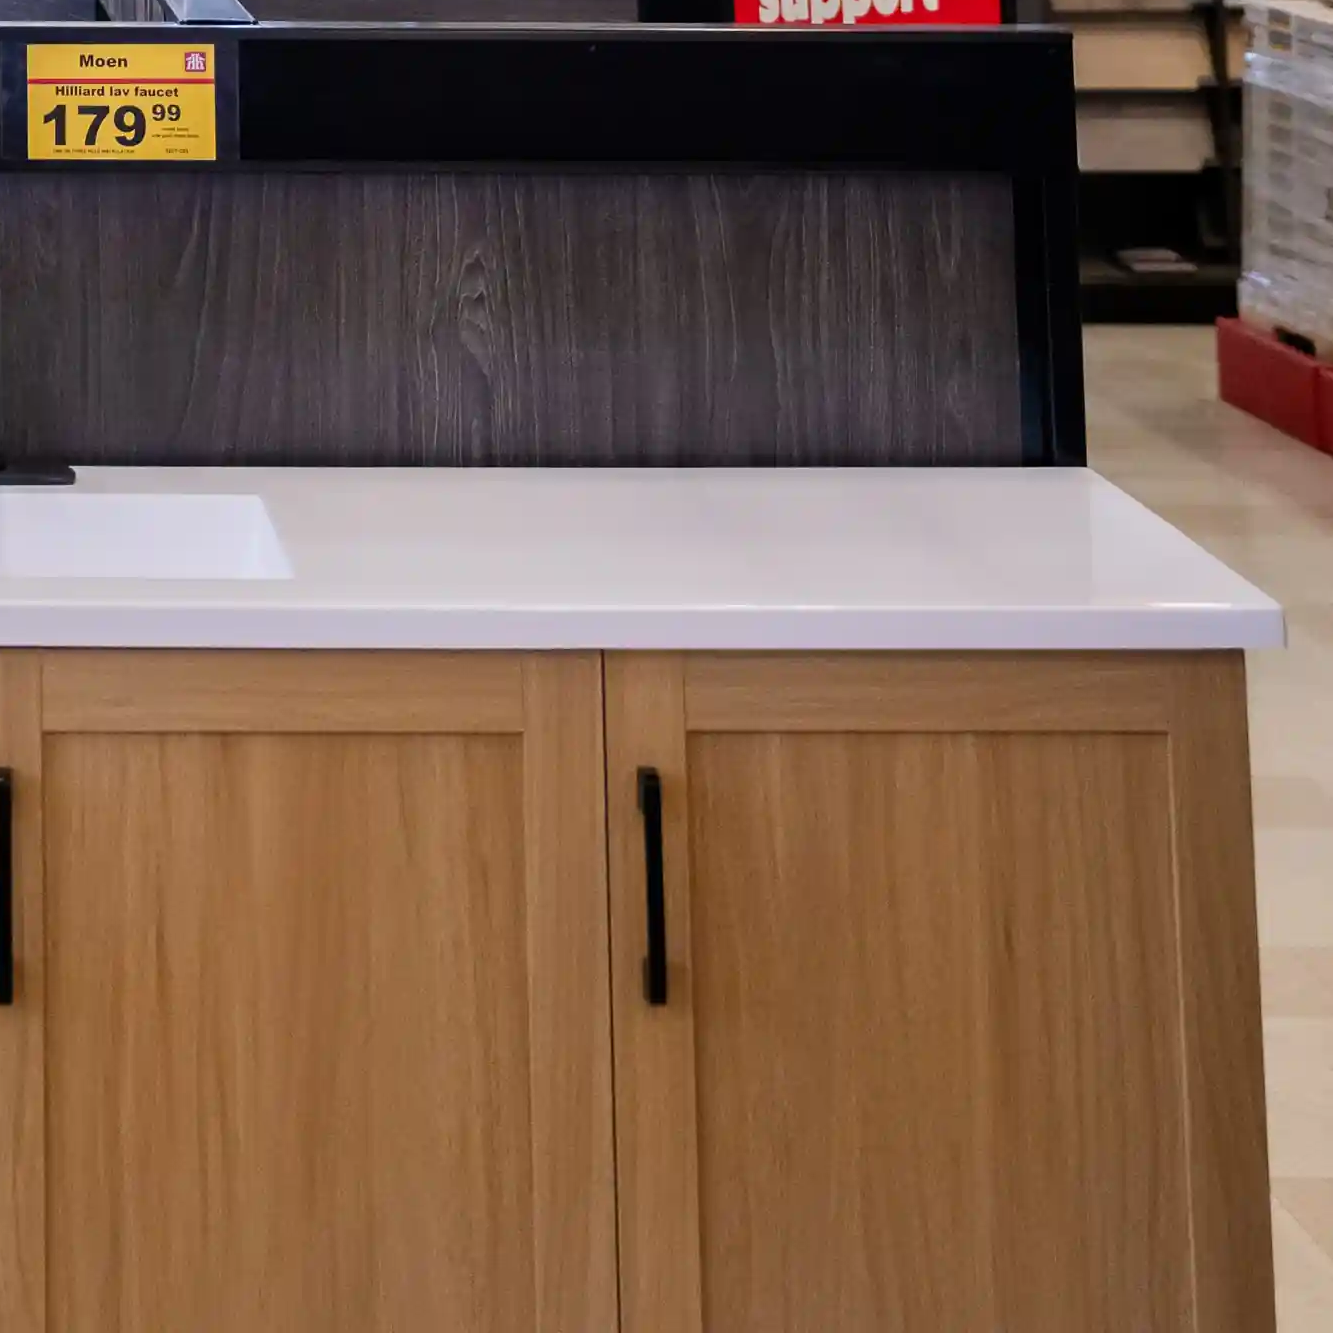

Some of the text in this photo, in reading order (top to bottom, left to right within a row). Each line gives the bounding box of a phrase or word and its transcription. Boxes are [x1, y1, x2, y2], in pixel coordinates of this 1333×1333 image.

[79, 54, 128, 68] Moen
[55, 86, 179, 98] Hilliard lav faucet
[43, 104, 147, 147] 179
[151, 104, 181, 121] 99
